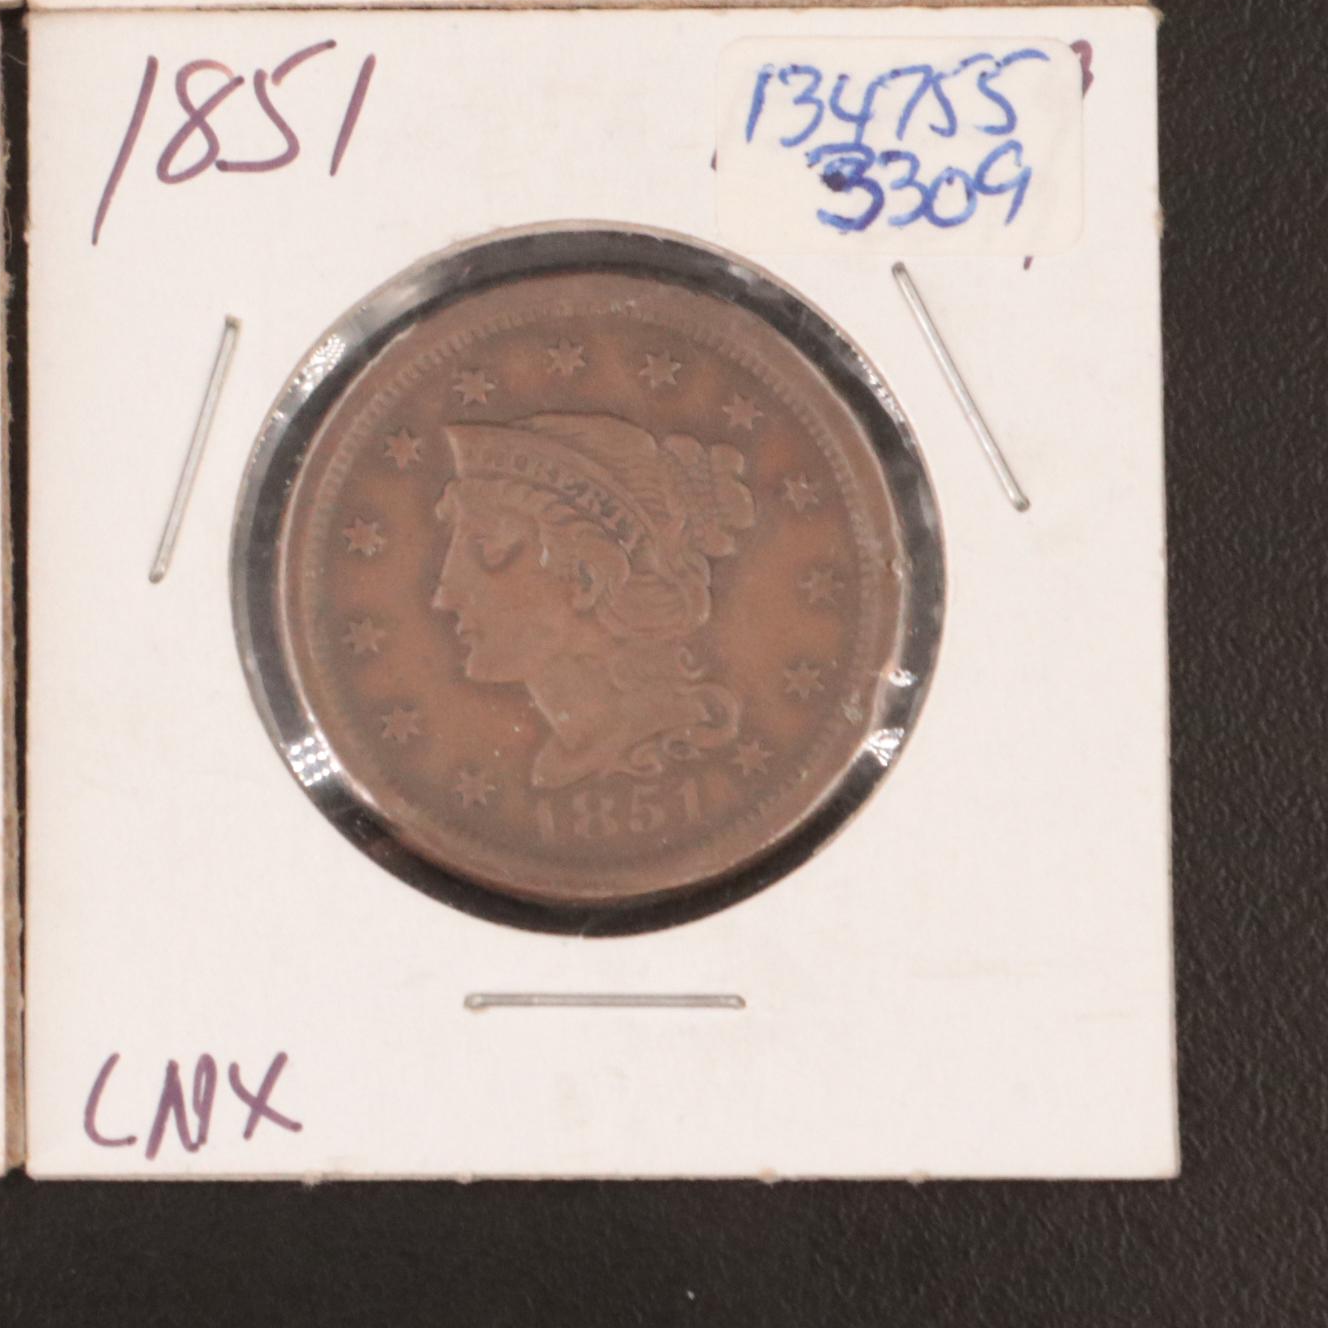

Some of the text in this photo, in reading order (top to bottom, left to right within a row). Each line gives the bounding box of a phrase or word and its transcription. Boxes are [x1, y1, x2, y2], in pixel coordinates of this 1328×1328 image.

[92, 40, 377, 245] 1851
[746, 48, 1051, 148] 134755
[534, 775, 705, 845] 1851
